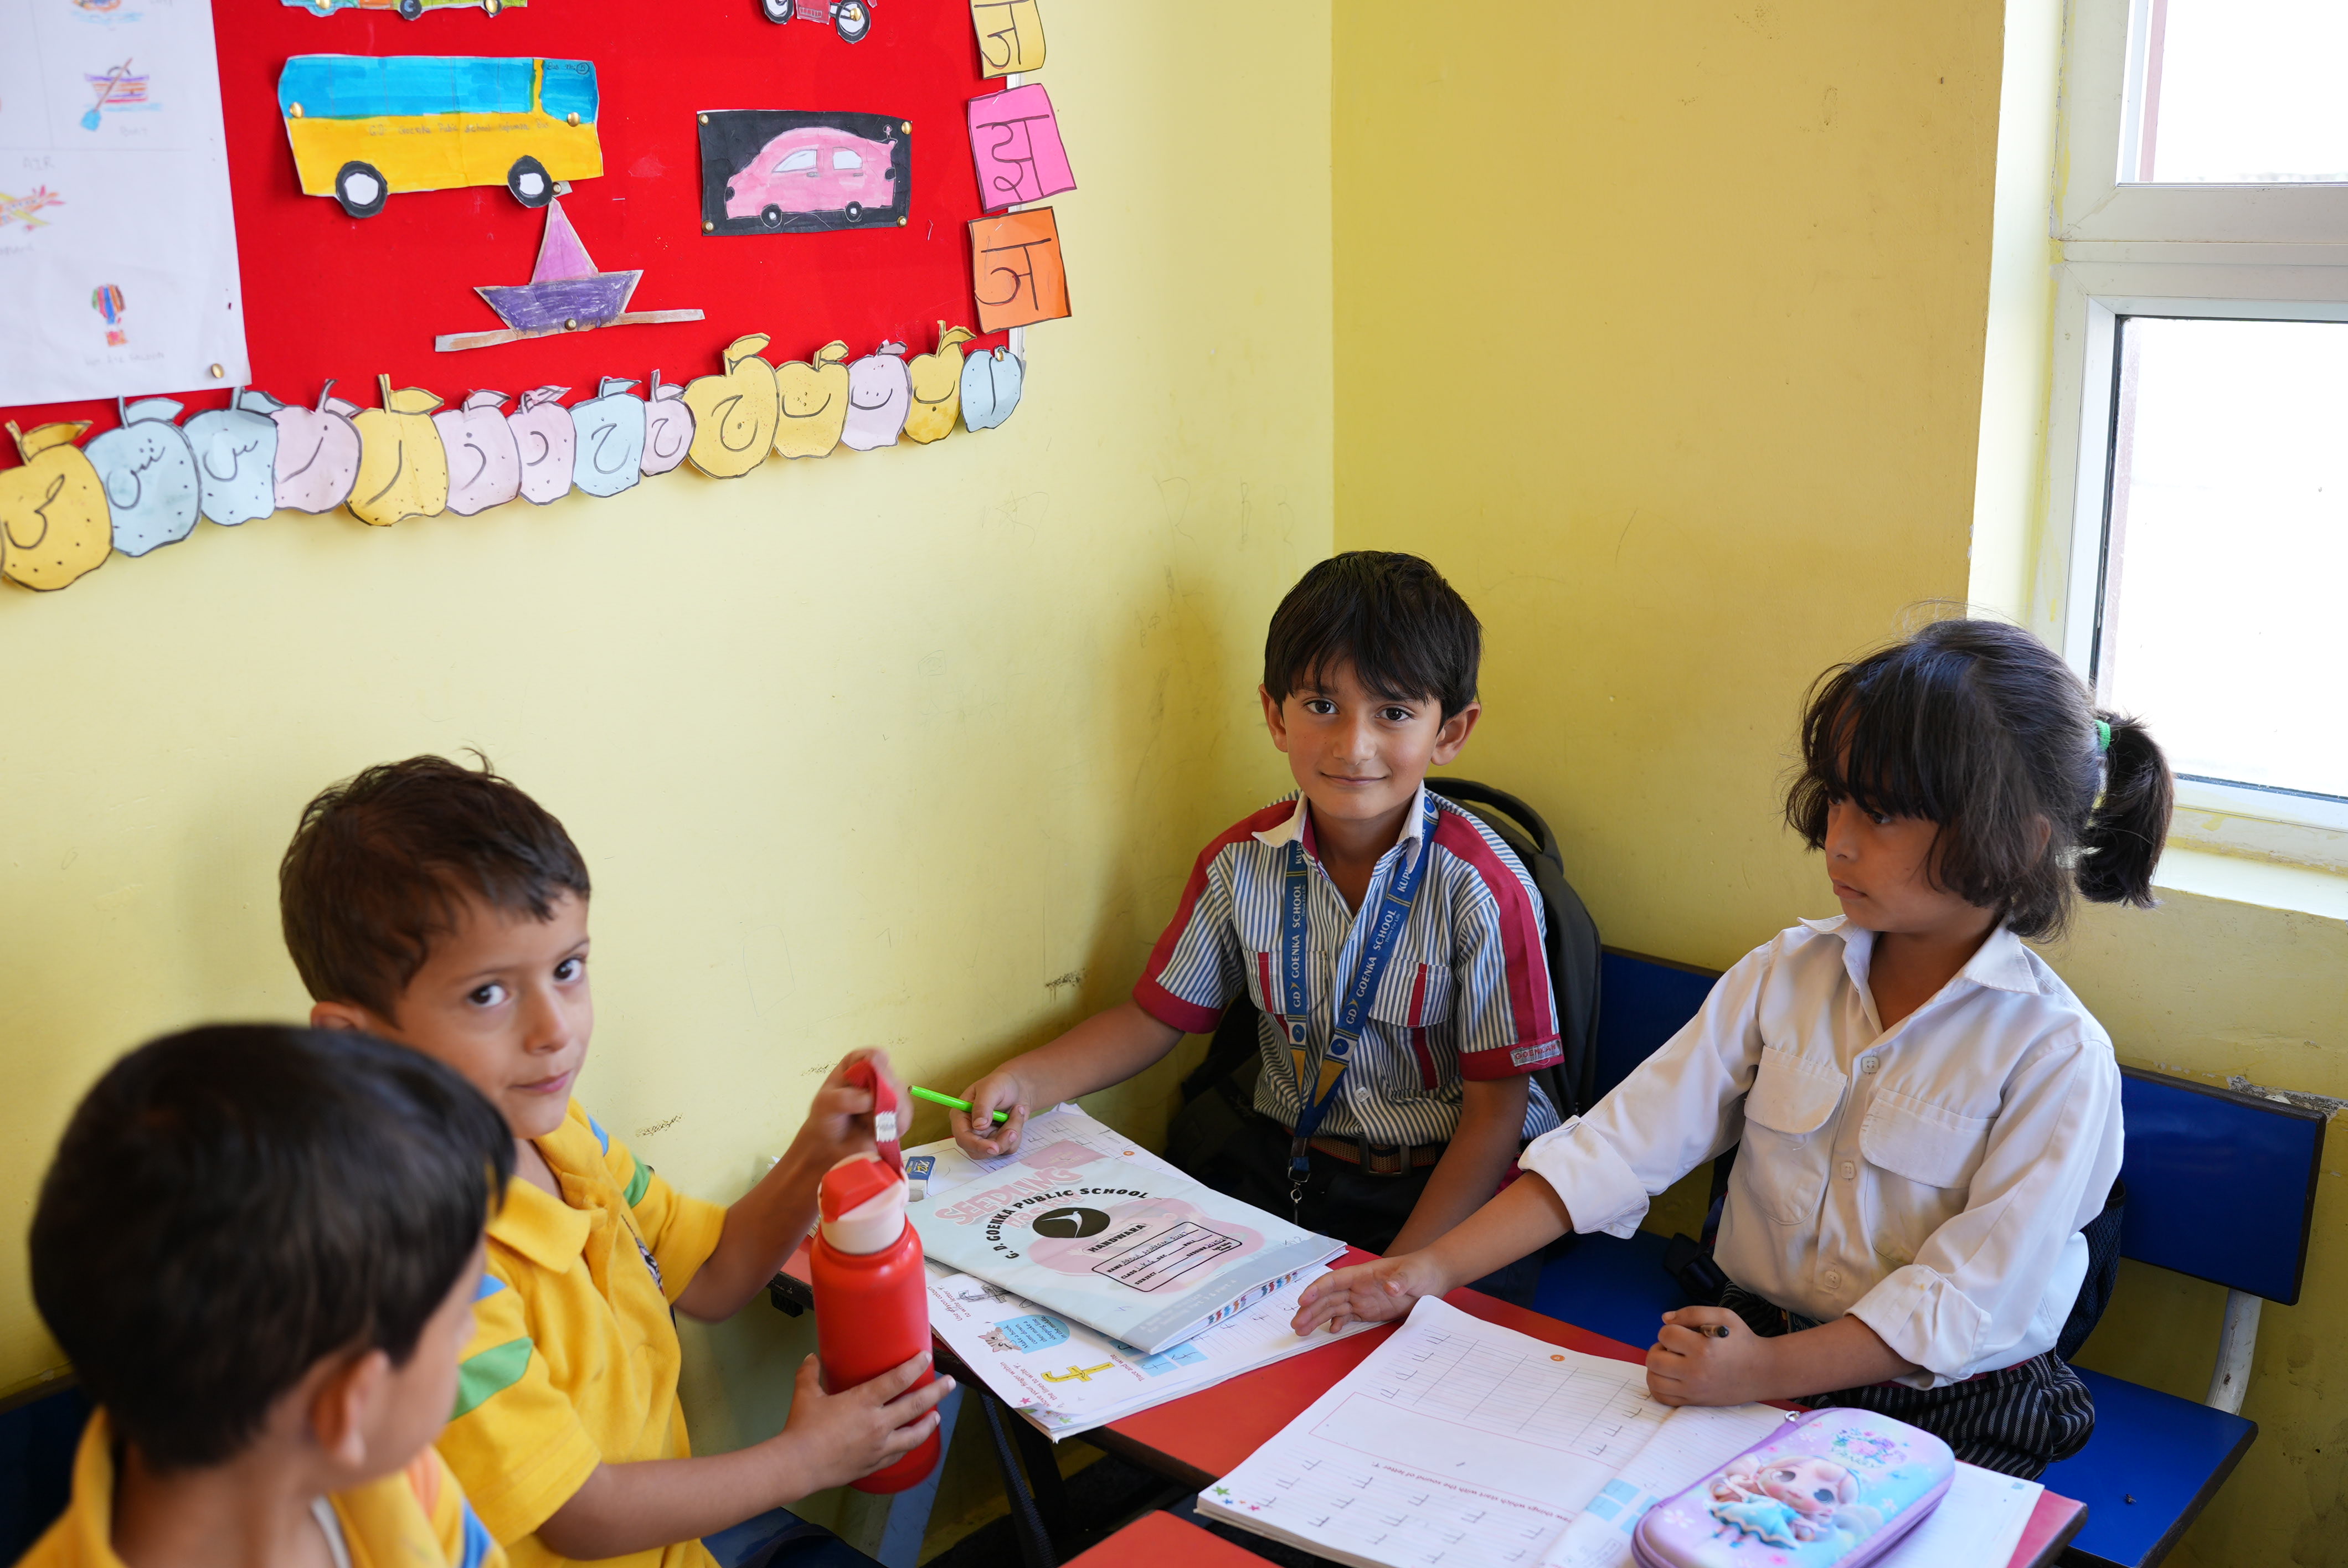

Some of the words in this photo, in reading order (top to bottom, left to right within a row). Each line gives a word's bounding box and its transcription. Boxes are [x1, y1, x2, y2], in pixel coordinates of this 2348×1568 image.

[1292, 884, 1302, 928] SCHOOL
[1291, 934, 1300, 978] GOENKA
[1346, 1008, 1357, 1024] GD
[1356, 957, 1377, 997] GOENKA
[1373, 910, 1397, 951] SCHOOL
[1293, 991, 1301, 1008] GD
[935, 1167, 1084, 1226] SEEDLING
[986, 1209, 1011, 1242] GOENKA
[1012, 1189, 1075, 1210] PUBLIC
[1079, 1188, 1150, 1199] SCHOOL
[1087, 1224, 1146, 1252] HANDWARA
[1106, 1264, 1124, 1273] NAME
[1121, 1269, 1137, 1279] CLASS
[1134, 1272, 1157, 1285] SUBJECT
[944, 1290, 957, 1304] letter
[952, 1309, 962, 1322] Use
[1032, 1318, 1041, 1326] line
[1026, 1323, 1039, 1335] make
[1041, 1324, 1057, 1340] sleeping
[1026, 1334, 1038, 1344] come
[1036, 1332, 1047, 1342] then
[1000, 1361, 1016, 1378] within
[1020, 1368, 1033, 1379] write
[1122, 1363, 1134, 1373] and
[1013, 1374, 1027, 1388] finger
[1131, 1371, 1145, 1381] Trace
[1026, 1386, 1040, 1396] your
[1037, 1382, 1049, 1394] lines
[1036, 1395, 1052, 1407] Move
[1048, 1392, 1058, 1400] the
[1383, 1464, 1404, 1476] letter
[1416, 1474, 1441, 1485] sound
[1443, 1481, 1457, 1490] the
[1459, 1486, 1478, 1495] with
[1479, 1492, 1499, 1501] start
[1500, 1497, 1526, 1509] which
